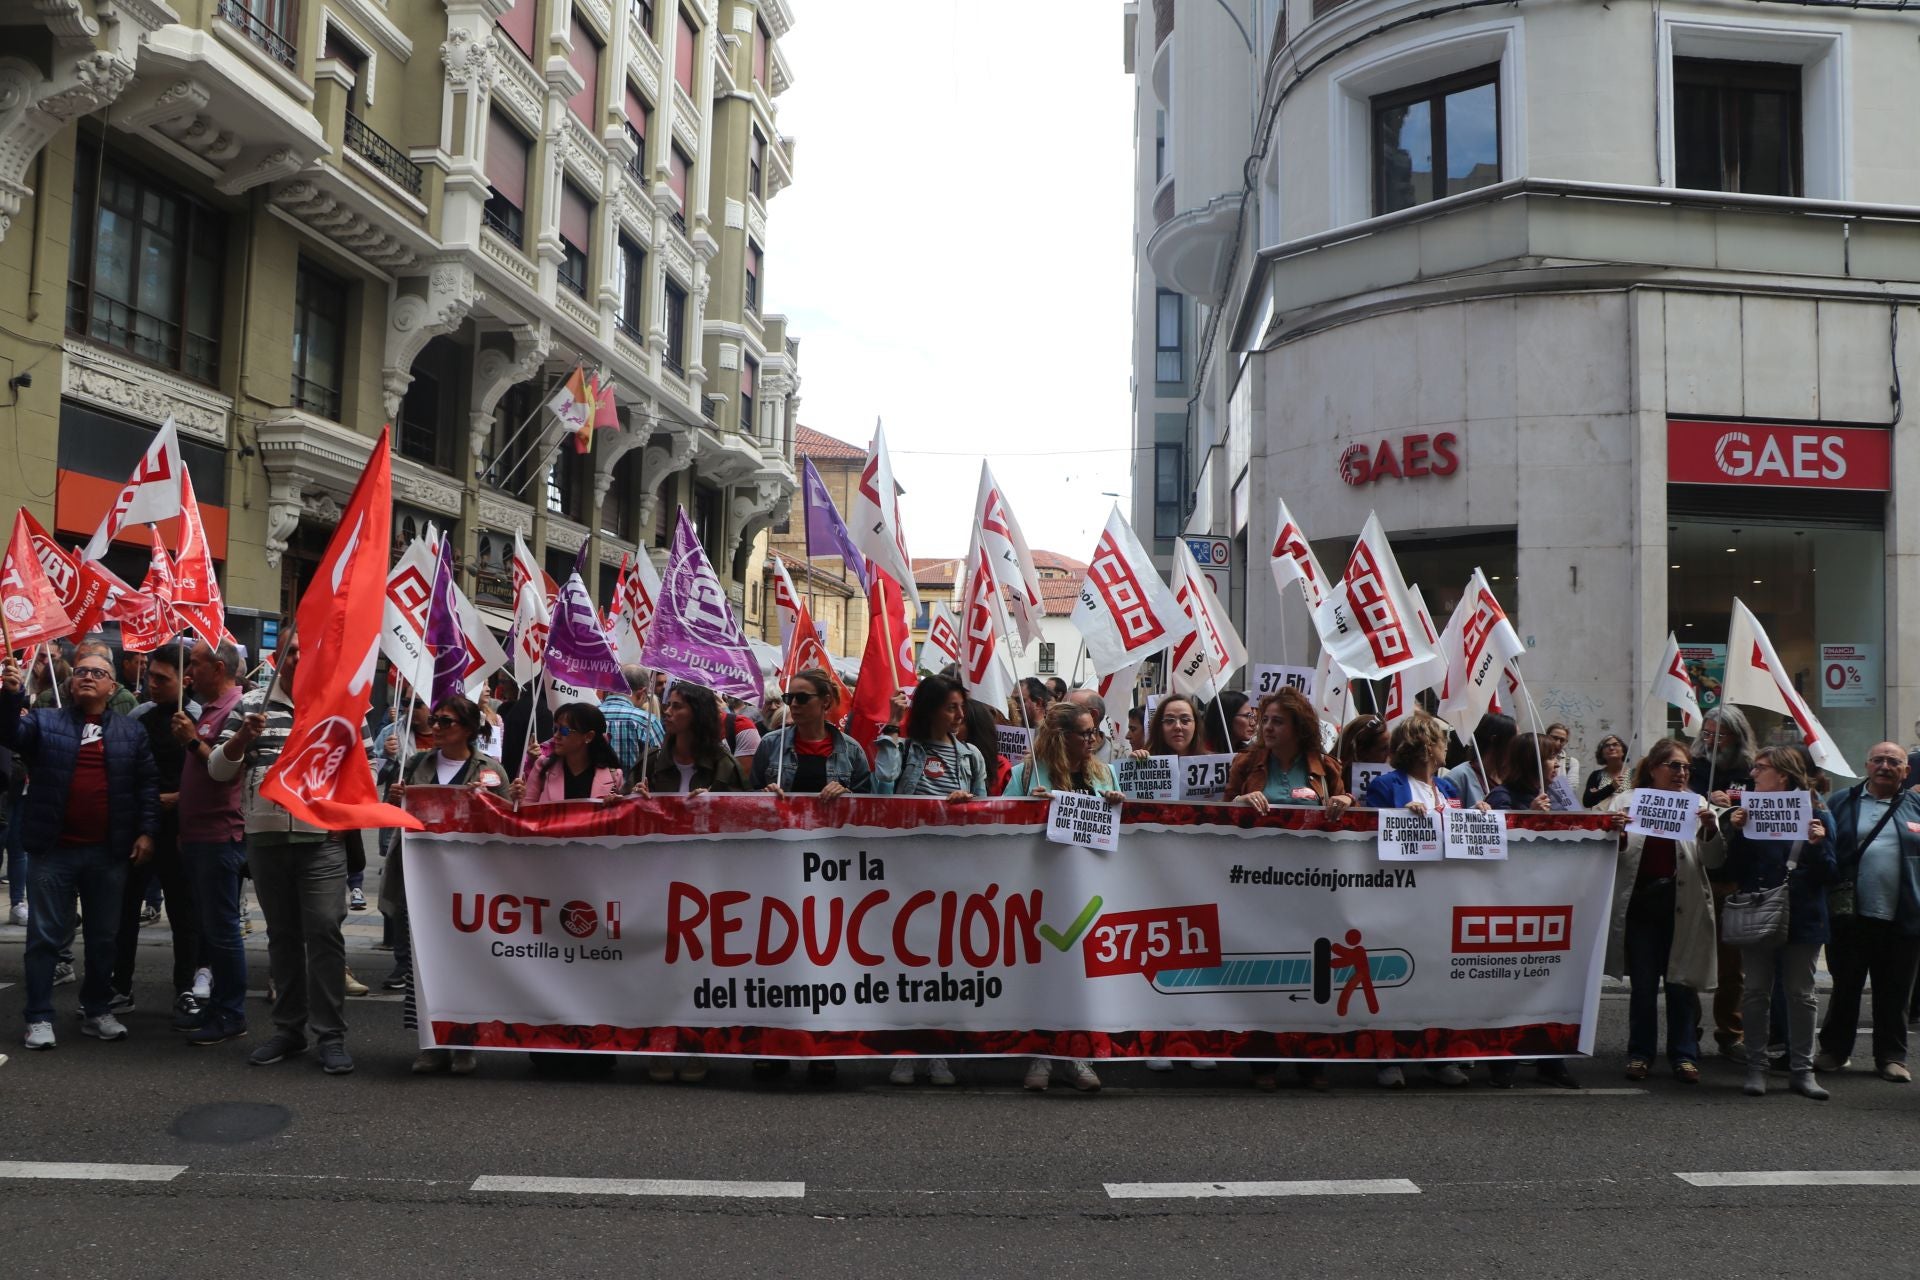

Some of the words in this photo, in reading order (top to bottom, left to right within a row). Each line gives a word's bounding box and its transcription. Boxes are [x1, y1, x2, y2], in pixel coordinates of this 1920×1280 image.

[1340, 432, 1459, 486] GAES
[1715, 432, 1847, 480] GAES
[1215, 549, 1224, 557] 10
[393, 625, 419, 659] León
[1183, 650, 1205, 677] Leó
[1475, 653, 1494, 688] León
[1260, 672, 1306, 693] 375h
[1120, 761, 1134, 772] LOS
[1159, 759, 1170, 769] DE
[1119, 770, 1138, 781] PAPÁ
[1140, 769, 1171, 780] QUIEREN
[1134, 780, 1172, 791] TRABAJES
[1137, 790, 1154, 800] MÁS
[1640, 794, 1666, 807] 37,5h
[1676, 798, 1690, 809] ME
[1060, 795, 1076, 807] LOS
[1076, 797, 1101, 811] NIÑOS
[1102, 801, 1113, 813] DE
[1748, 798, 1775, 809] 37,5h
[1786, 798, 1801, 808] ME
[1057, 806, 1079, 819] PAPÁ
[1080, 810, 1113, 825] QUIEREN
[1450, 812, 1463, 823] LOS
[1465, 811, 1486, 824] NIÑOS
[1488, 814, 1497, 823] DE
[1637, 806, 1677, 820] PRESENTO
[1680, 810, 1686, 821] A
[1749, 810, 1792, 821] PRESENTO
[1794, 811, 1801, 820] A
[1055, 817, 1071, 829] QUE
[1073, 820, 1112, 836] TRABAJES
[1450, 823, 1469, 833] PAPÁ
[1470, 824, 1499, 834] QUIEREN
[1640, 818, 1681, 832] DIPUTADO
[1756, 822, 1798, 833] DIPUTADO
[1072, 831, 1092, 844] MÁS
[1383, 830, 1393, 841] DE
[1395, 830, 1437, 842] JORNADA
[1450, 834, 1463, 844] QUE
[1465, 834, 1501, 845] TRABAJES
[1401, 842, 1419, 855] ¡YA!
[1467, 844, 1484, 856] MÁS
[803, 852, 851, 882] Por
[859, 851, 885, 881] la
[1230, 865, 1417, 893] #reducciónjornadaYA
[452, 892, 550, 934] UGT
[664, 881, 1044, 968] REDUCCIÓN
[1461, 915, 1566, 944] CCOO
[491, 941, 559, 958] Castilla
[564, 947, 575, 963] y
[580, 945, 623, 961] León
[1451, 954, 1518, 967] comisiones
[1520, 953, 1561, 965] obreras
[1450, 968, 1466, 980] de
[1468, 967, 1512, 980] Castilla
[1514, 969, 1521, 980] y
[1523, 966, 1551, 978] León
[693, 977, 737, 1009] del
[744, 977, 847, 1015] tiempo
[854, 972, 889, 1005] de
[895, 971, 1003, 1008] trabajo
